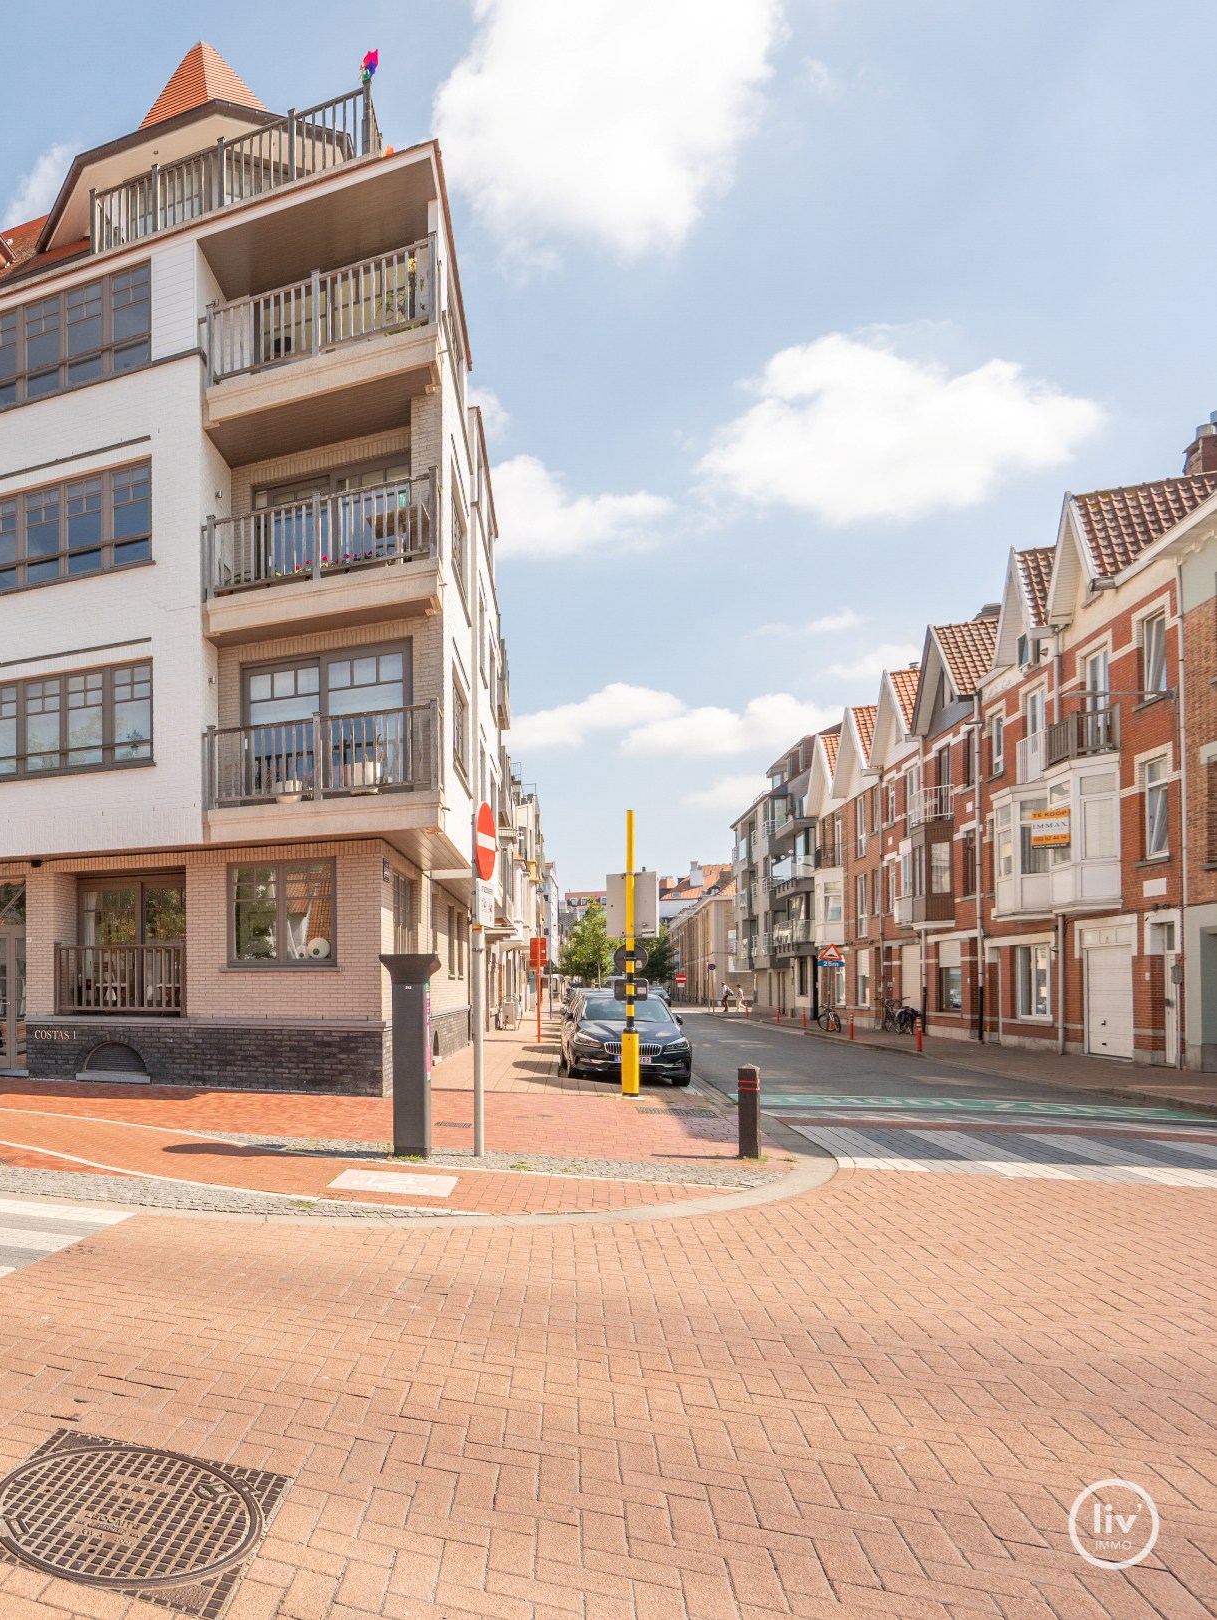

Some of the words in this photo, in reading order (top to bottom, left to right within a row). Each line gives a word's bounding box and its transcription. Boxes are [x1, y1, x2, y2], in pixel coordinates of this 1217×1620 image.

[1033, 821, 1068, 829] IMMAX
[34, 1030, 70, 1040] COSTAS
[73, 1030, 77, 1040] 1
